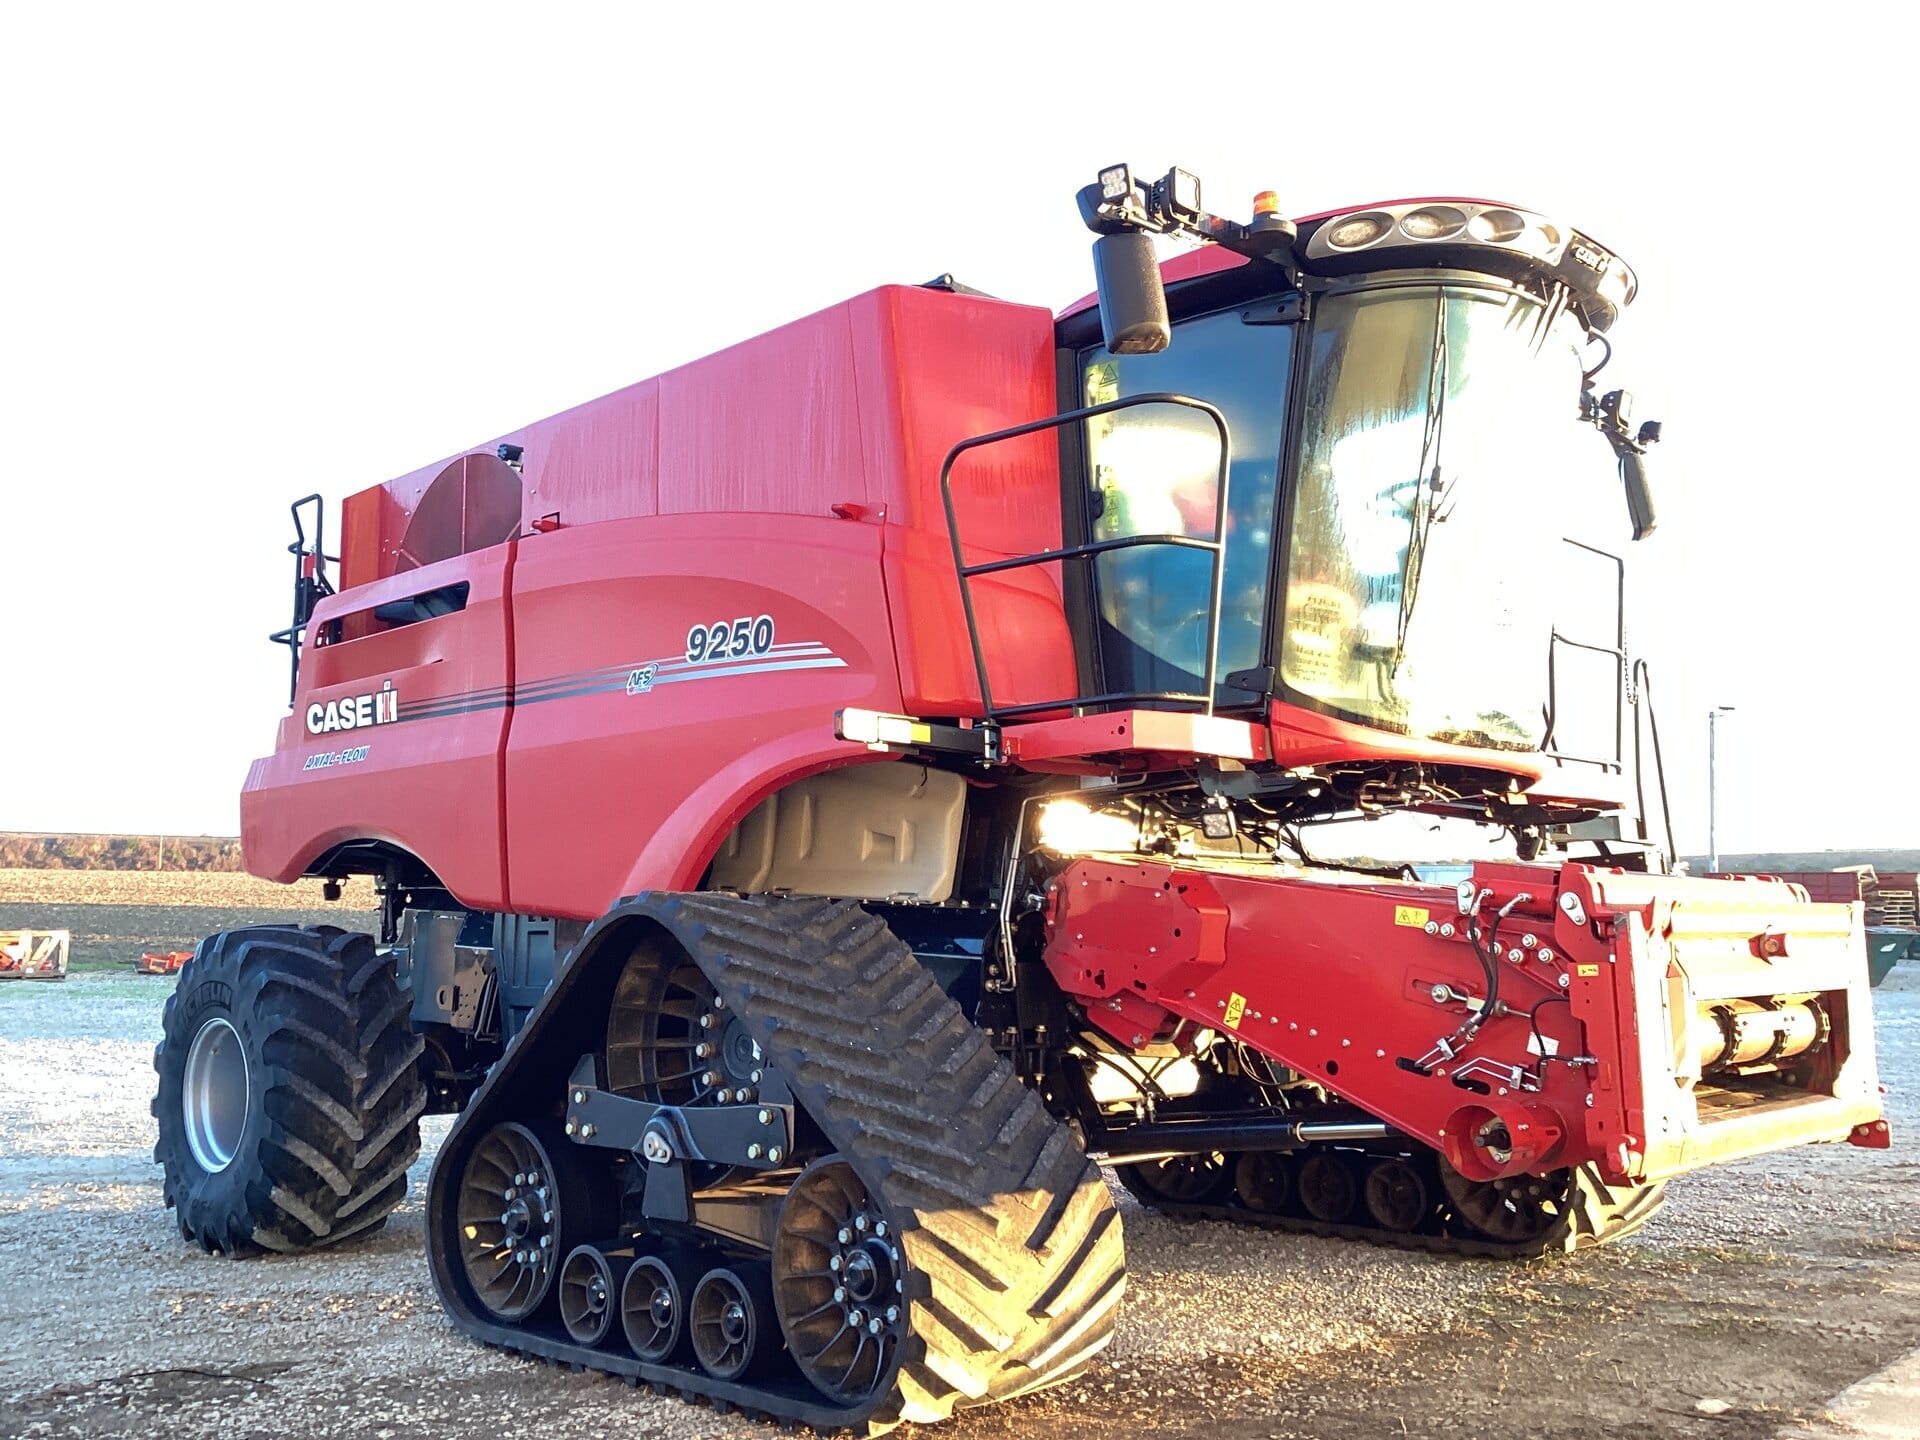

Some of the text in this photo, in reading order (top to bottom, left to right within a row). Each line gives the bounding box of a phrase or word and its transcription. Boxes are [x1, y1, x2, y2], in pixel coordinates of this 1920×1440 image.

[687, 615, 774, 663] 9250
[627, 667, 656, 688] AFS
[306, 695, 372, 734] CASE
